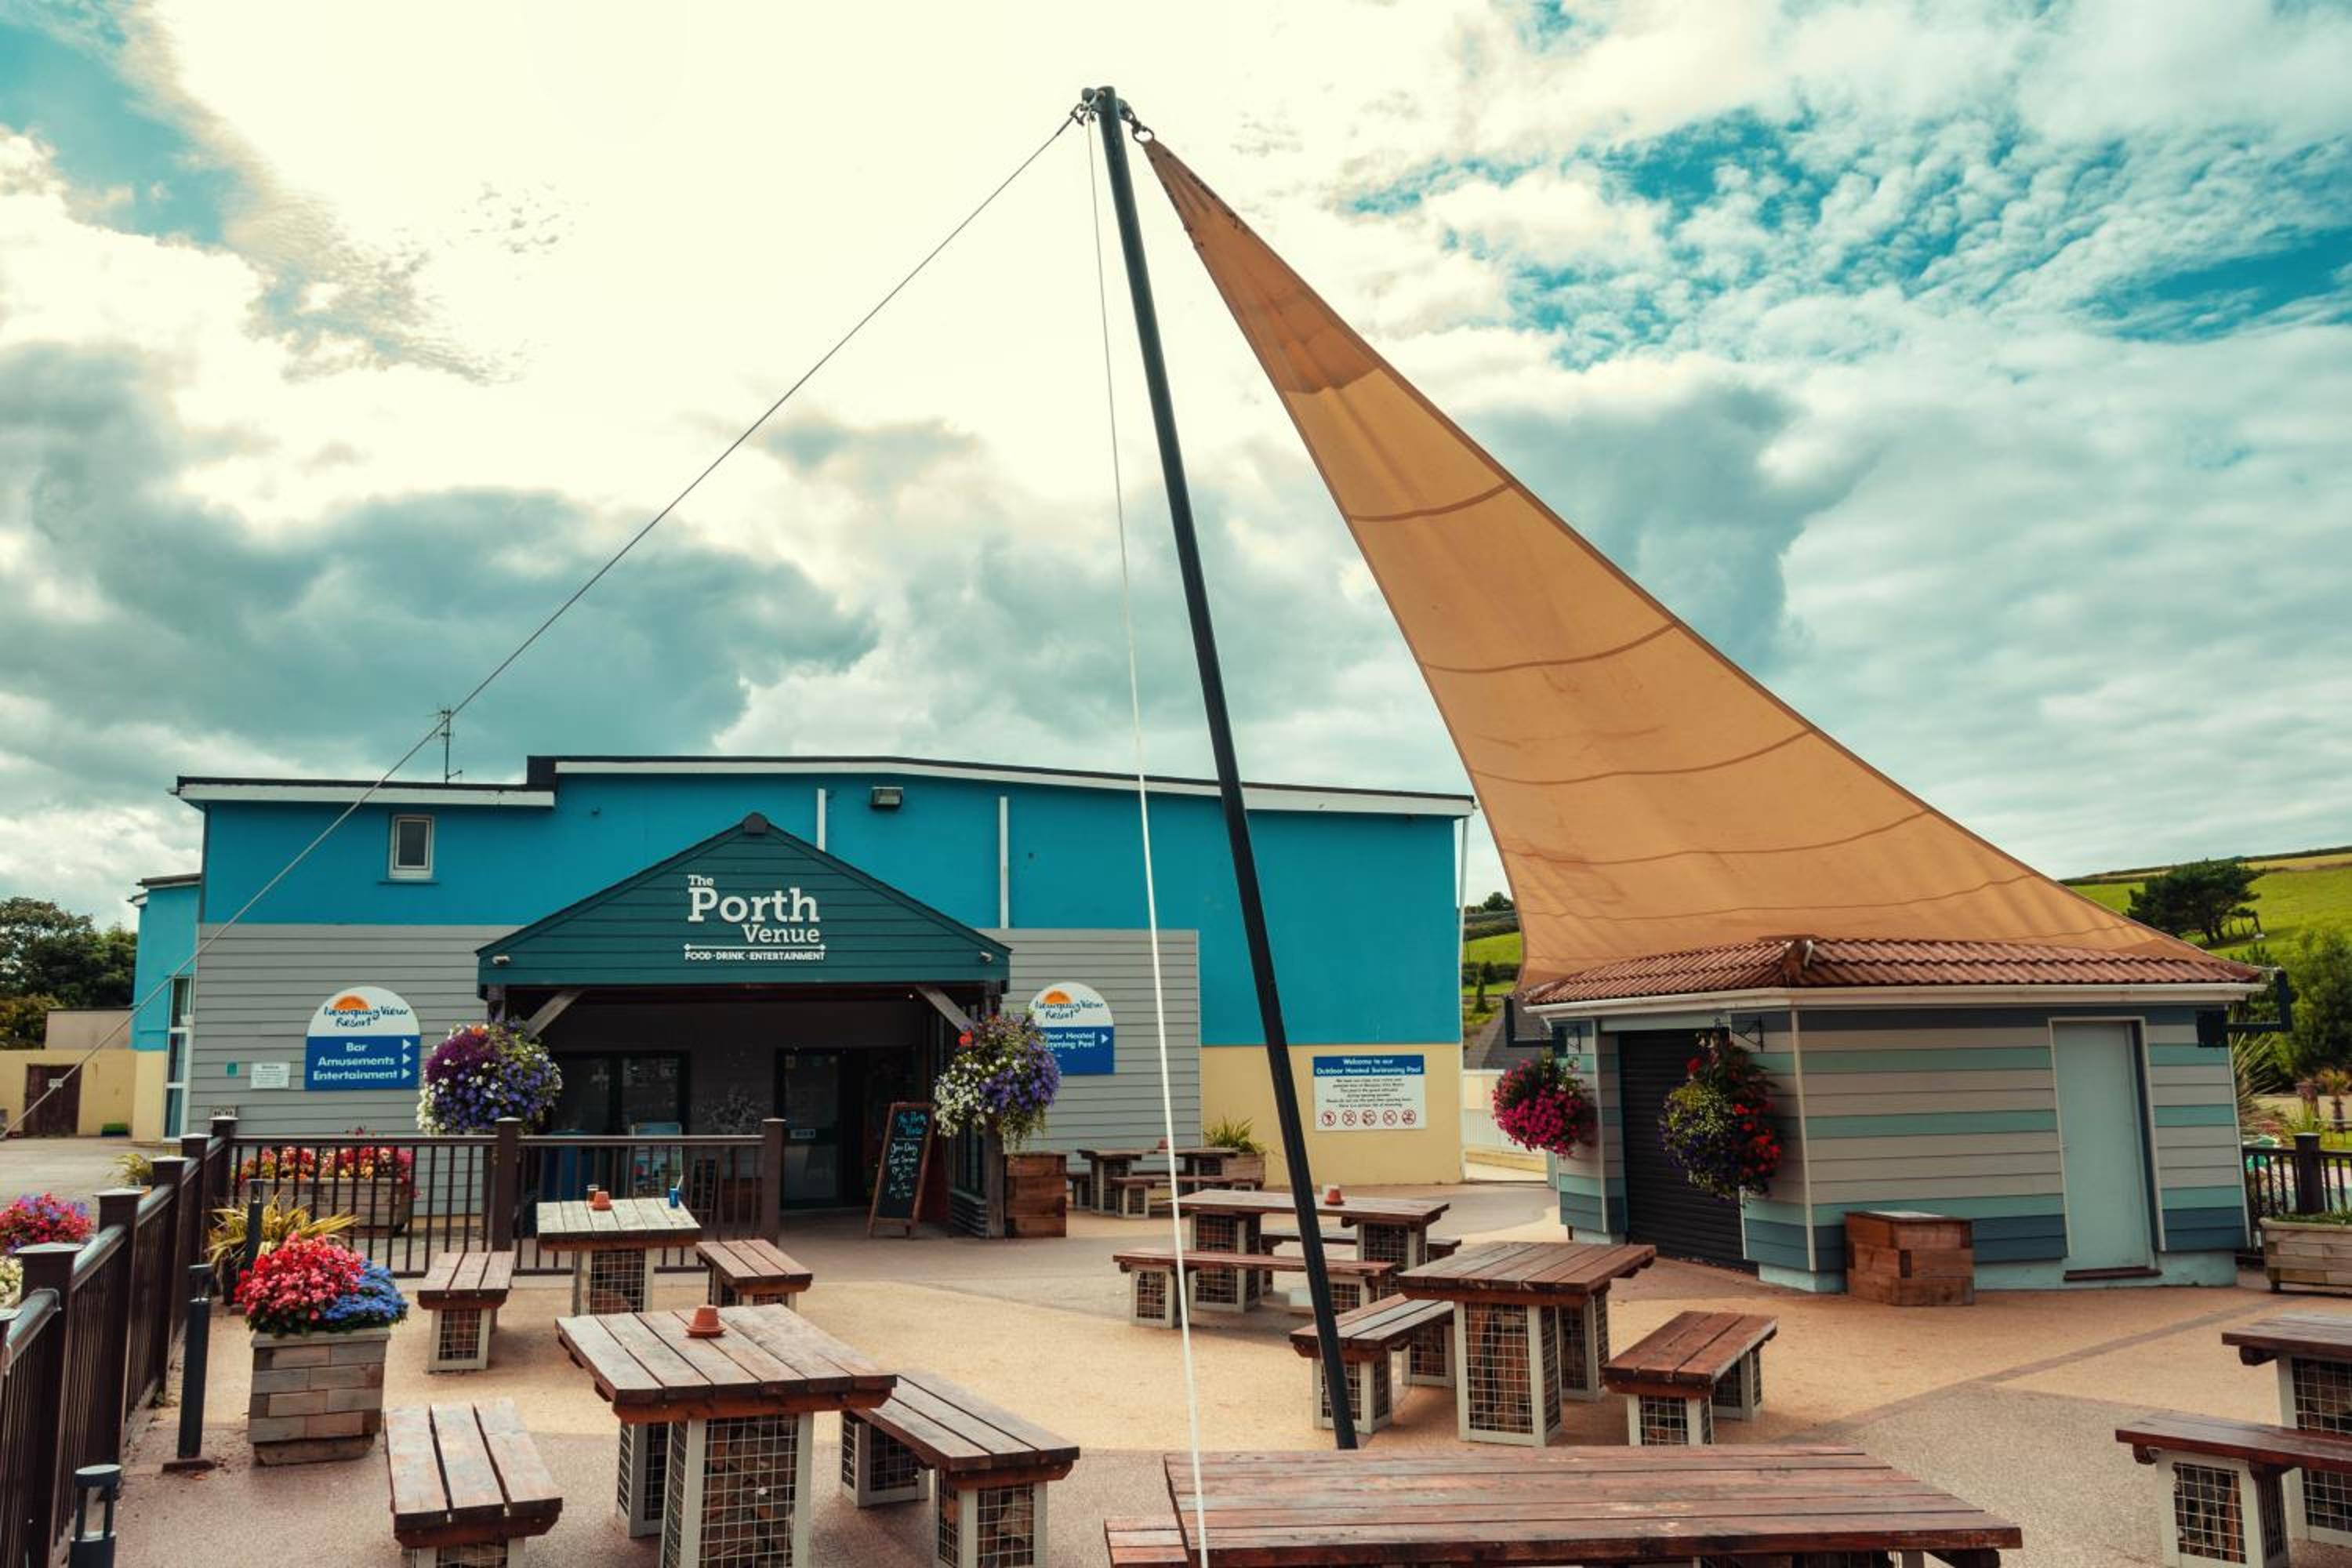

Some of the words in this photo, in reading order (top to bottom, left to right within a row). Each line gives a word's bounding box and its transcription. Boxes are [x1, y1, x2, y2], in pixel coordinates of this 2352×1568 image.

[688, 874, 714, 886] The
[688, 887, 820, 923] Porth
[742, 924, 820, 943] Venue
[684, 951, 711, 960] FOOD
[716, 951, 745, 960] DRINK
[750, 951, 826, 960] ENTERTAINMENT
[324, 1006, 381, 1020] Newquay
[380, 1006, 408, 1016] View
[335, 1018, 372, 1027] Resort
[346, 1042, 368, 1052] Bar
[1078, 1040, 1095, 1048] Pool
[318, 1056, 395, 1067] Amusements
[314, 1069, 397, 1081] Entertainment
